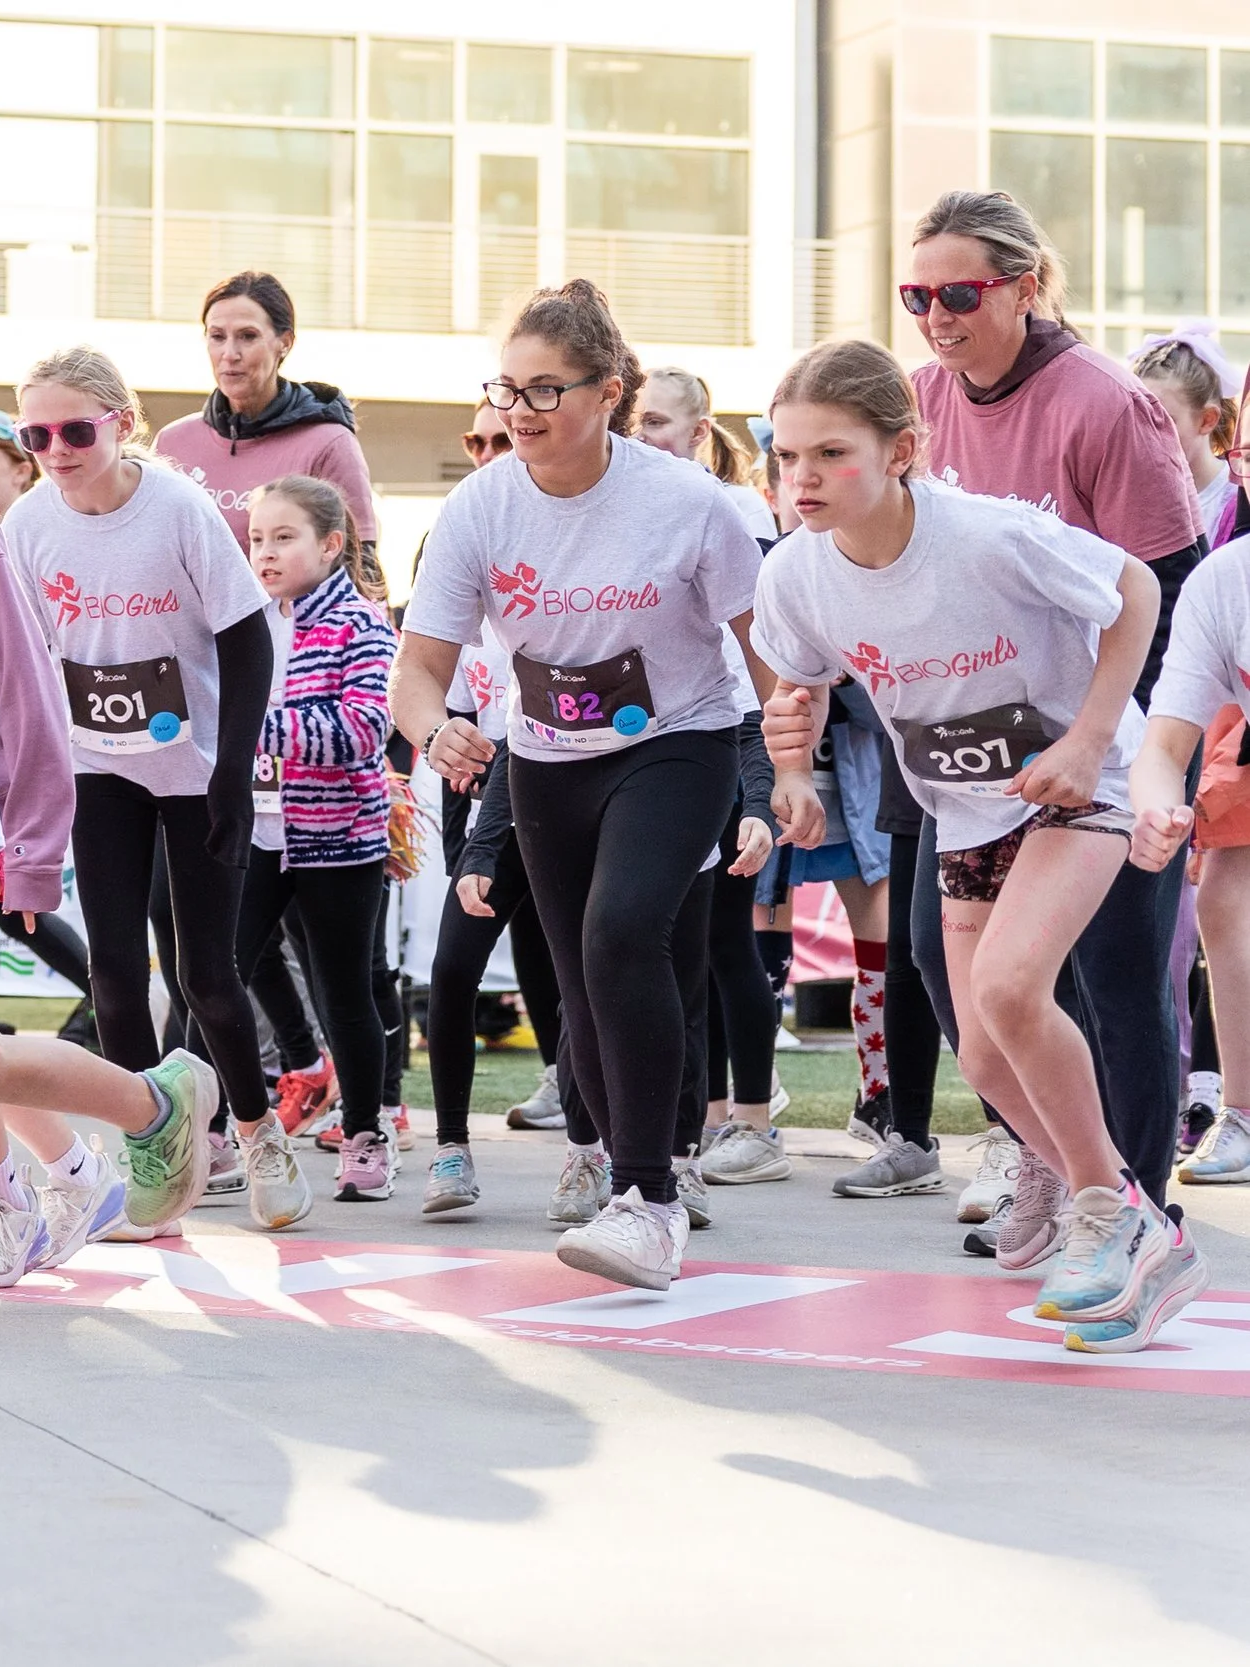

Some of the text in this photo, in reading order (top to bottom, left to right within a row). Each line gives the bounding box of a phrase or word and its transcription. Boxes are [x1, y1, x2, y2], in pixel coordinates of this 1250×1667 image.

[84, 589, 181, 619] BIOGirls
[543, 581, 662, 616] BIOGirls
[895, 634, 1019, 684] BIOGirls
[87, 690, 147, 723] 201
[547, 691, 604, 721] 182
[929, 738, 1012, 775] 207
